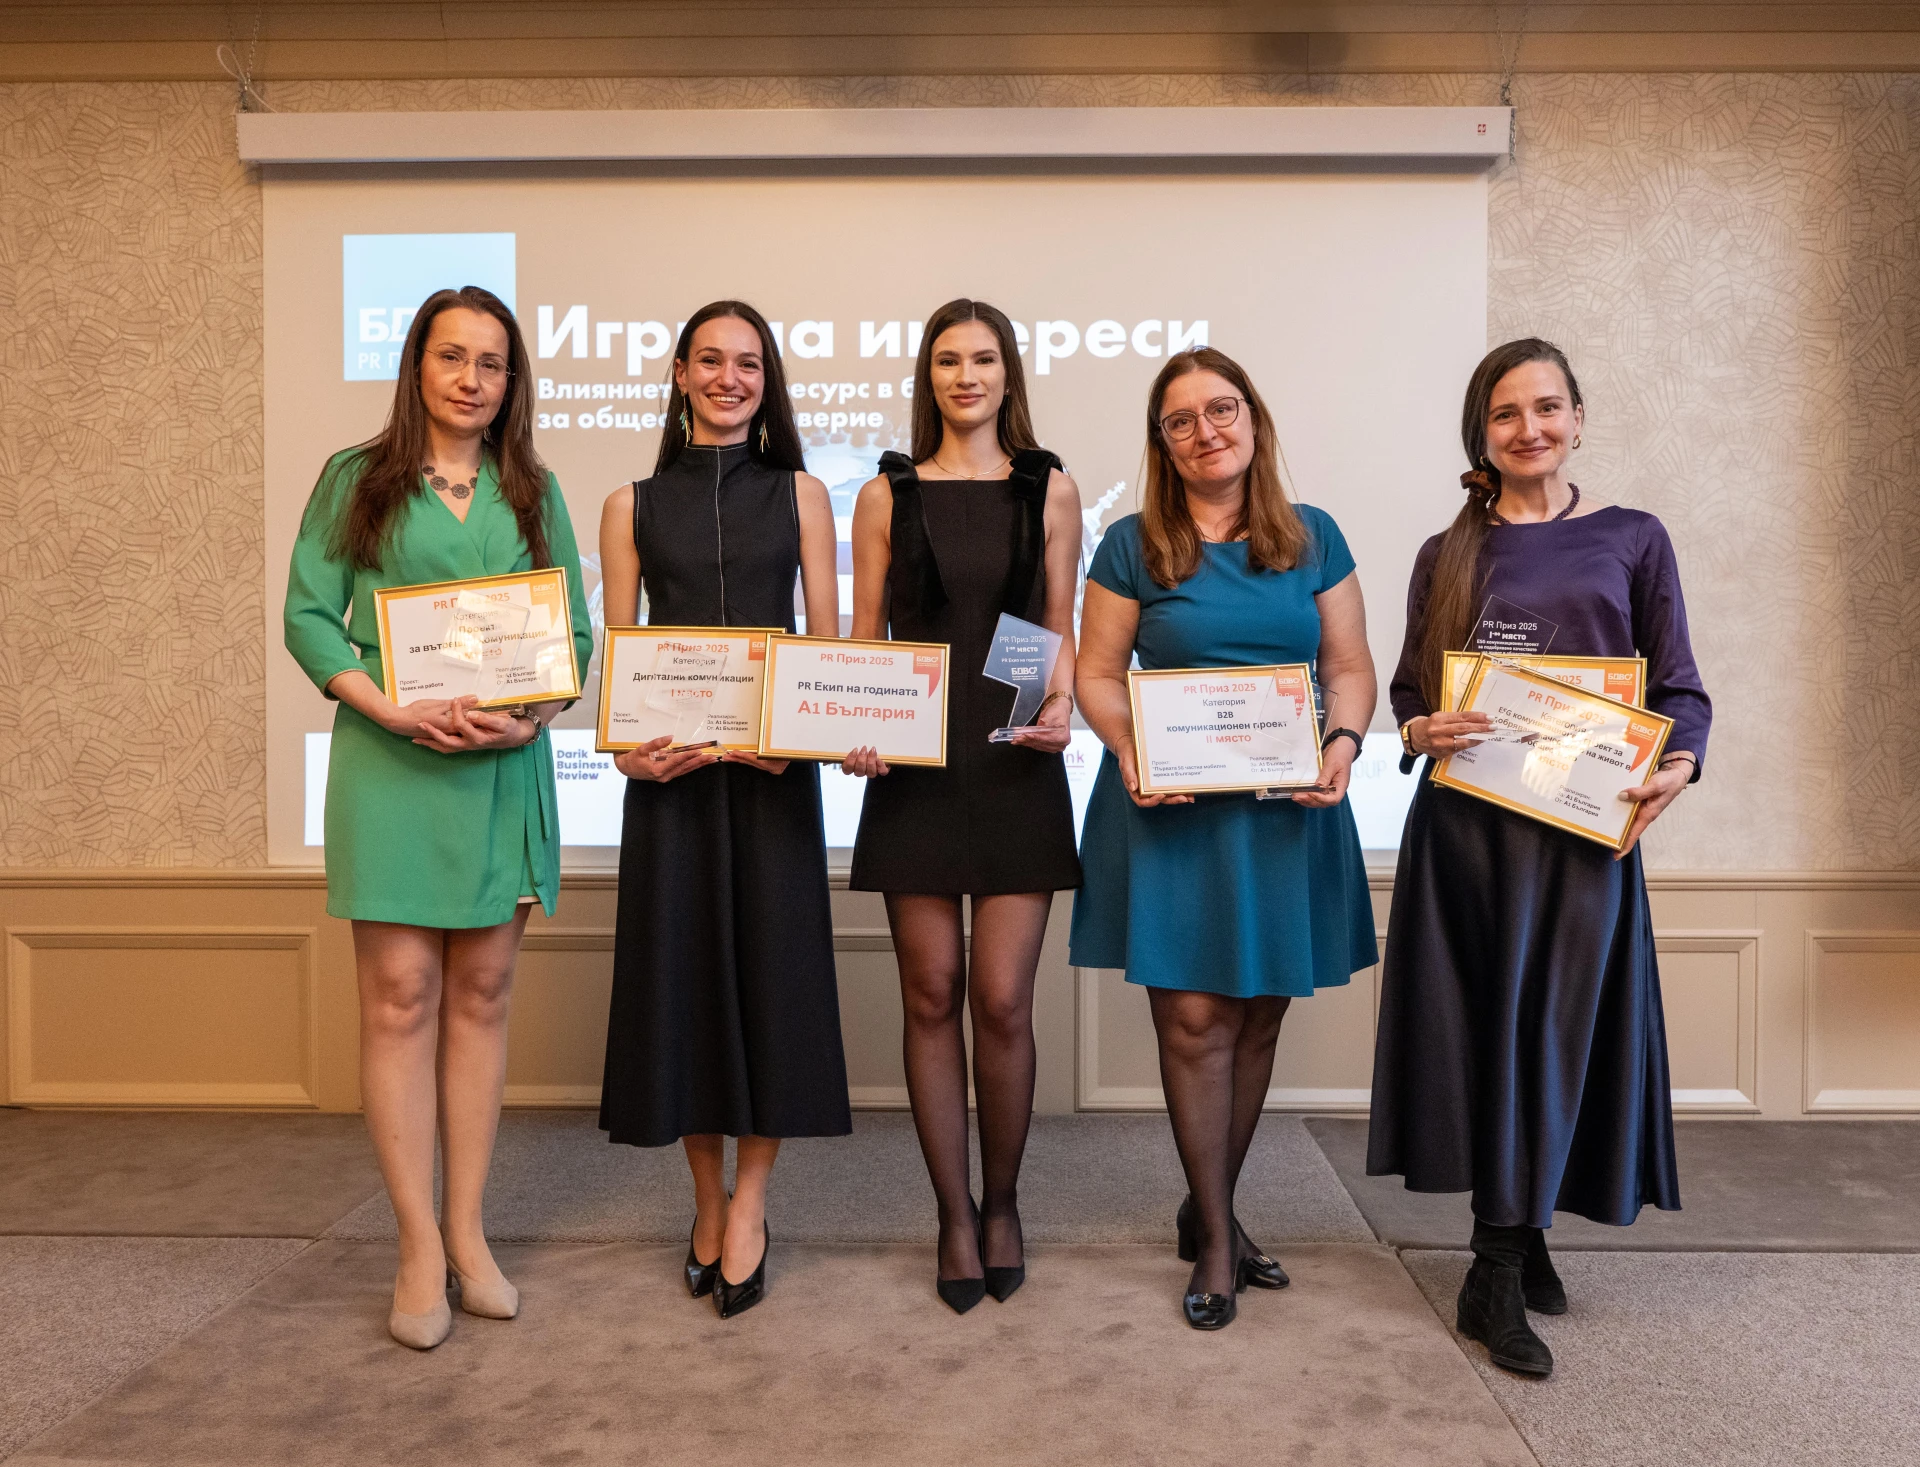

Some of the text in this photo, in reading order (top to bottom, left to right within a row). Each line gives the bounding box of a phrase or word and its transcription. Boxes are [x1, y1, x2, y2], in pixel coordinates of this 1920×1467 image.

[360, 308, 420, 342] БД
[538, 305, 688, 376] Игр
[358, 352, 381, 369] PR
[538, 378, 672, 400] Влияниет
[789, 382, 870, 404] есурс
[878, 383, 893, 398] в
[538, 404, 884, 434] за общес верие
[434, 600, 448, 610] PR
[1482, 620, 1538, 631] PR Приз 2025
[1011, 636, 1029, 644] Приз
[409, 646, 420, 654] за
[706, 644, 730, 653] 2025
[673, 657, 716, 667] Категория
[820, 653, 894, 666] PR Приз 2025
[798, 681, 918, 697] PR Екип на годината
[1184, 682, 1256, 695] PR Приз 2025
[1202, 698, 1246, 708] Категория
[1528, 690, 1606, 725] PR Приз 2025
[826, 702, 915, 721] България
[1166, 721, 1250, 733] комуникационен
[1216, 734, 1252, 743] място
[556, 749, 588, 758] Darik
[1613, 749, 1624, 757] за
[556, 760, 609, 769] Business
[1586, 750, 1596, 758] на
[1597, 754, 1624, 768] живот
[556, 771, 599, 780] Review
